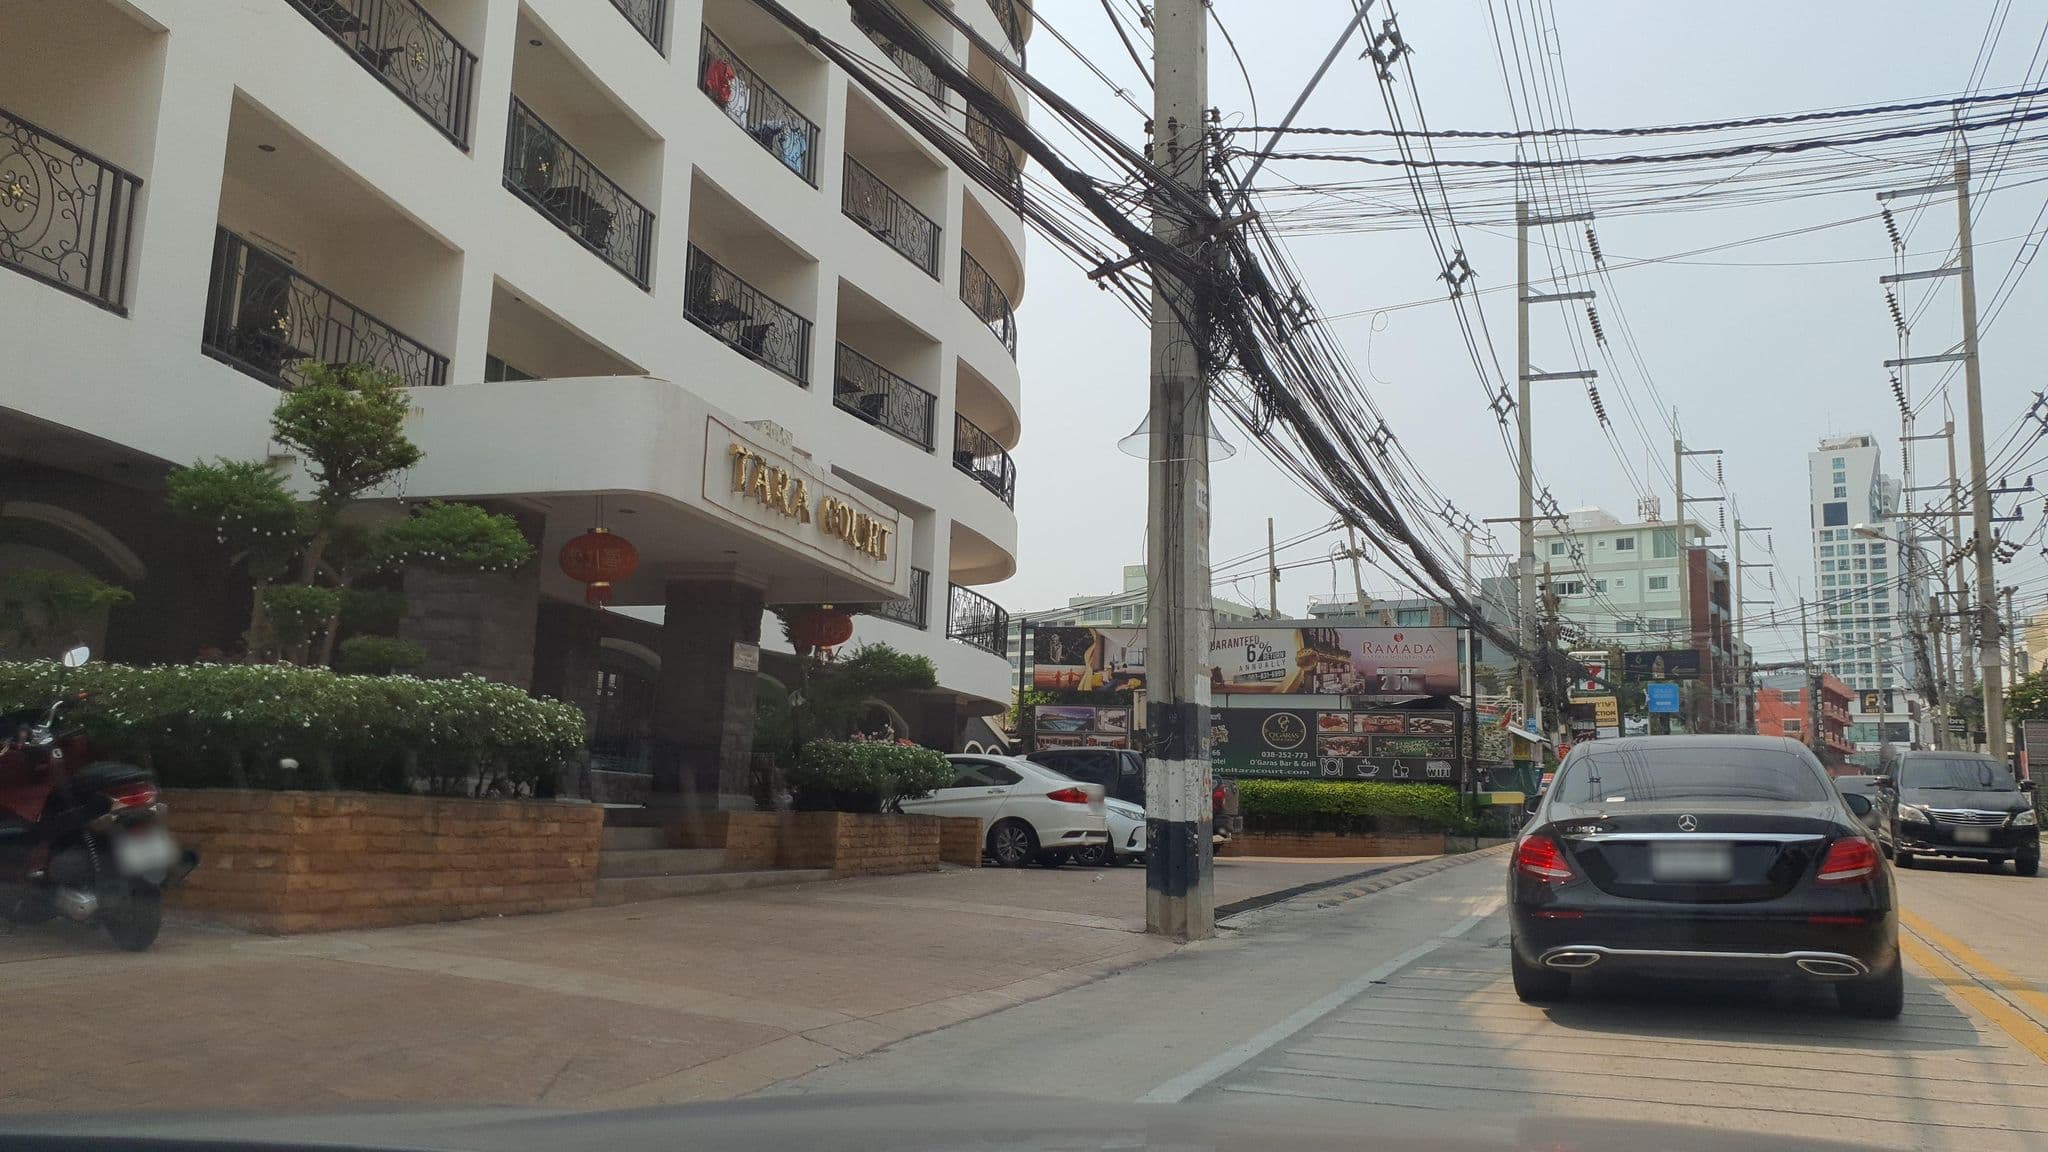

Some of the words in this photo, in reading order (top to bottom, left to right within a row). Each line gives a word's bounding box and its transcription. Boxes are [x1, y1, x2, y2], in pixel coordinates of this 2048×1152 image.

[729, 443, 810, 524] TARA
[817, 496, 892, 561] COURT
[1210, 635, 1260, 650] UARANTEED
[1362, 641, 1436, 654] RAMADA
[1239, 658, 1286, 672] ANNUALLY
[1249, 759, 1278, 767] O'Garas
[1293, 760, 1299, 768] &
[1301, 760, 1317, 769] Grill
[1212, 767, 1310, 776] oteltaracourt.com
[1428, 769, 1450, 777] WIFI
